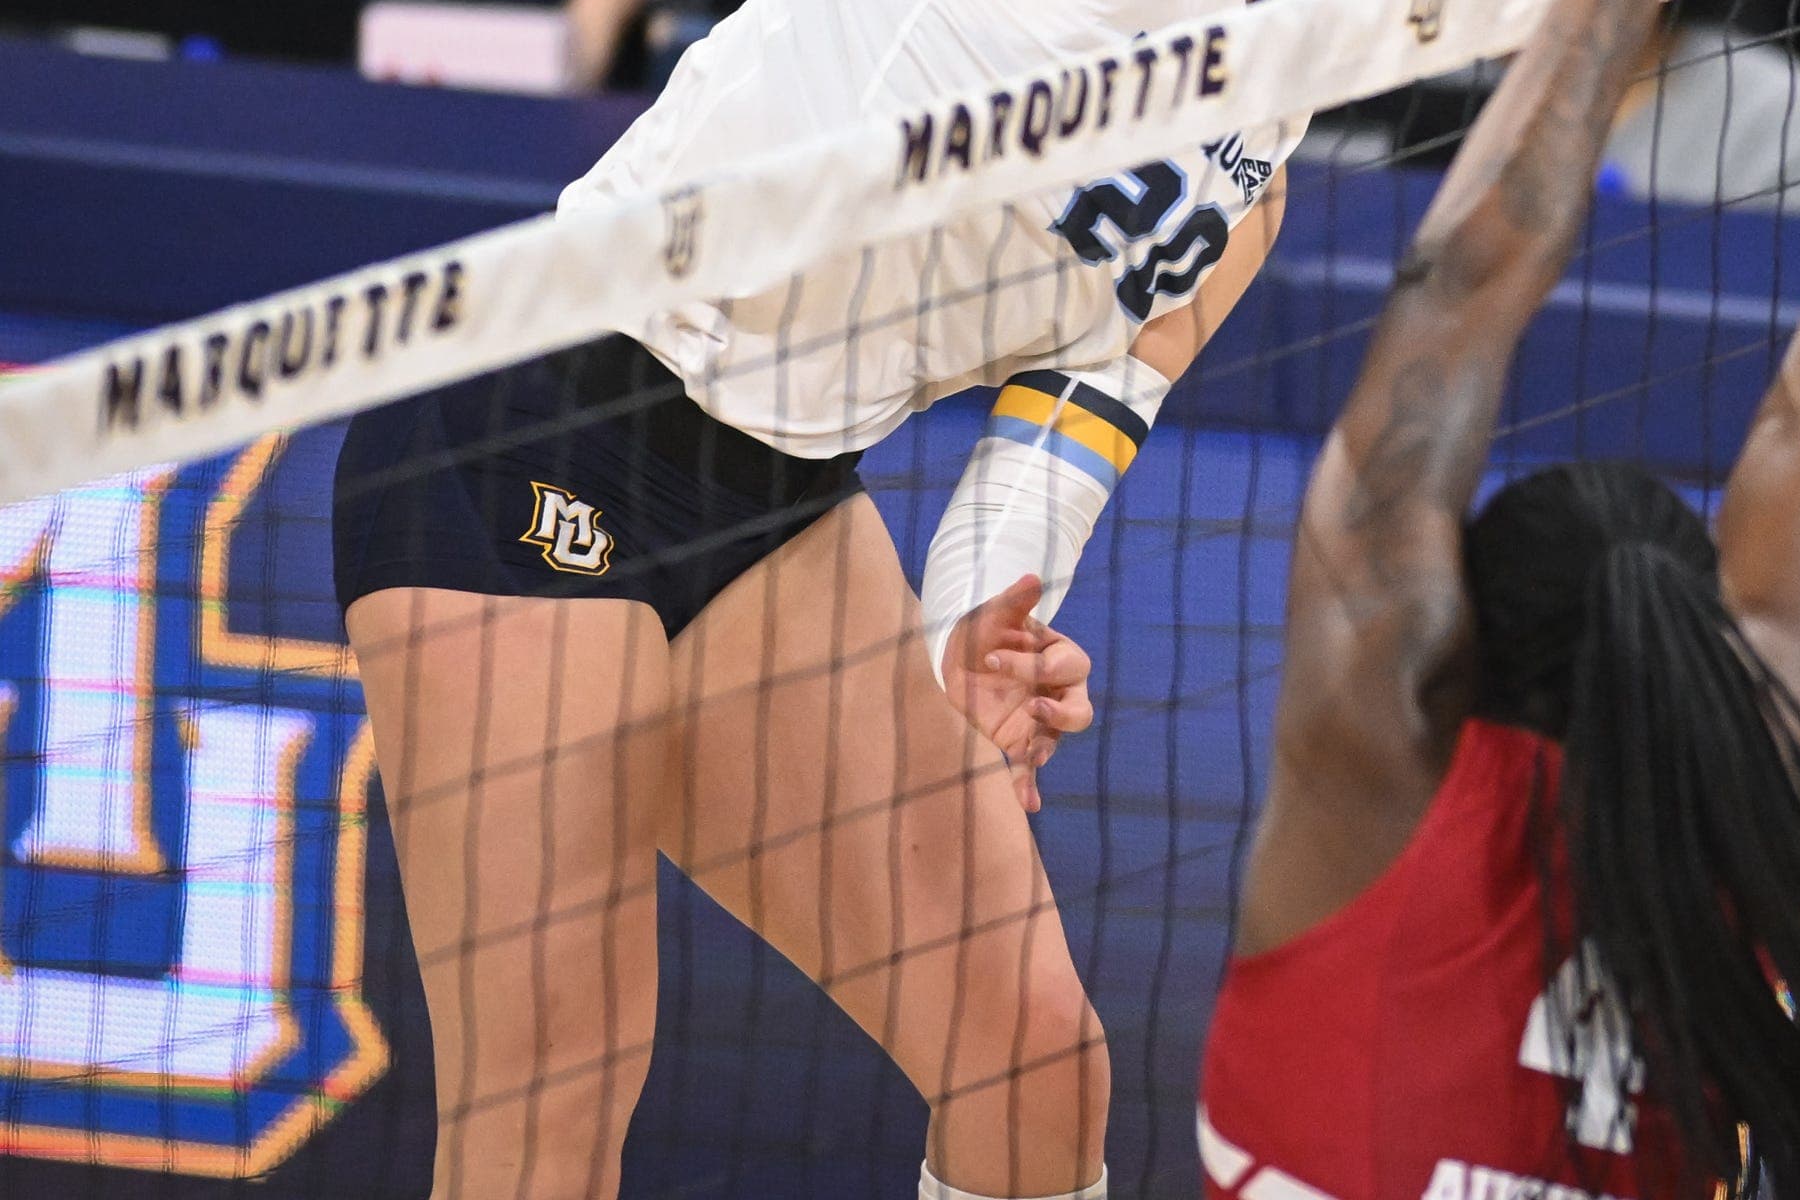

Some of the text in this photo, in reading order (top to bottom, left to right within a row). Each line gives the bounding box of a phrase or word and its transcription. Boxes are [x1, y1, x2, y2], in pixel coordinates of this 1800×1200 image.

[897, 25, 1226, 187] MARQUETTE
[1047, 157, 1230, 325] 20
[104, 261, 463, 433] MARQUETTE
[529, 487, 610, 572] MU
